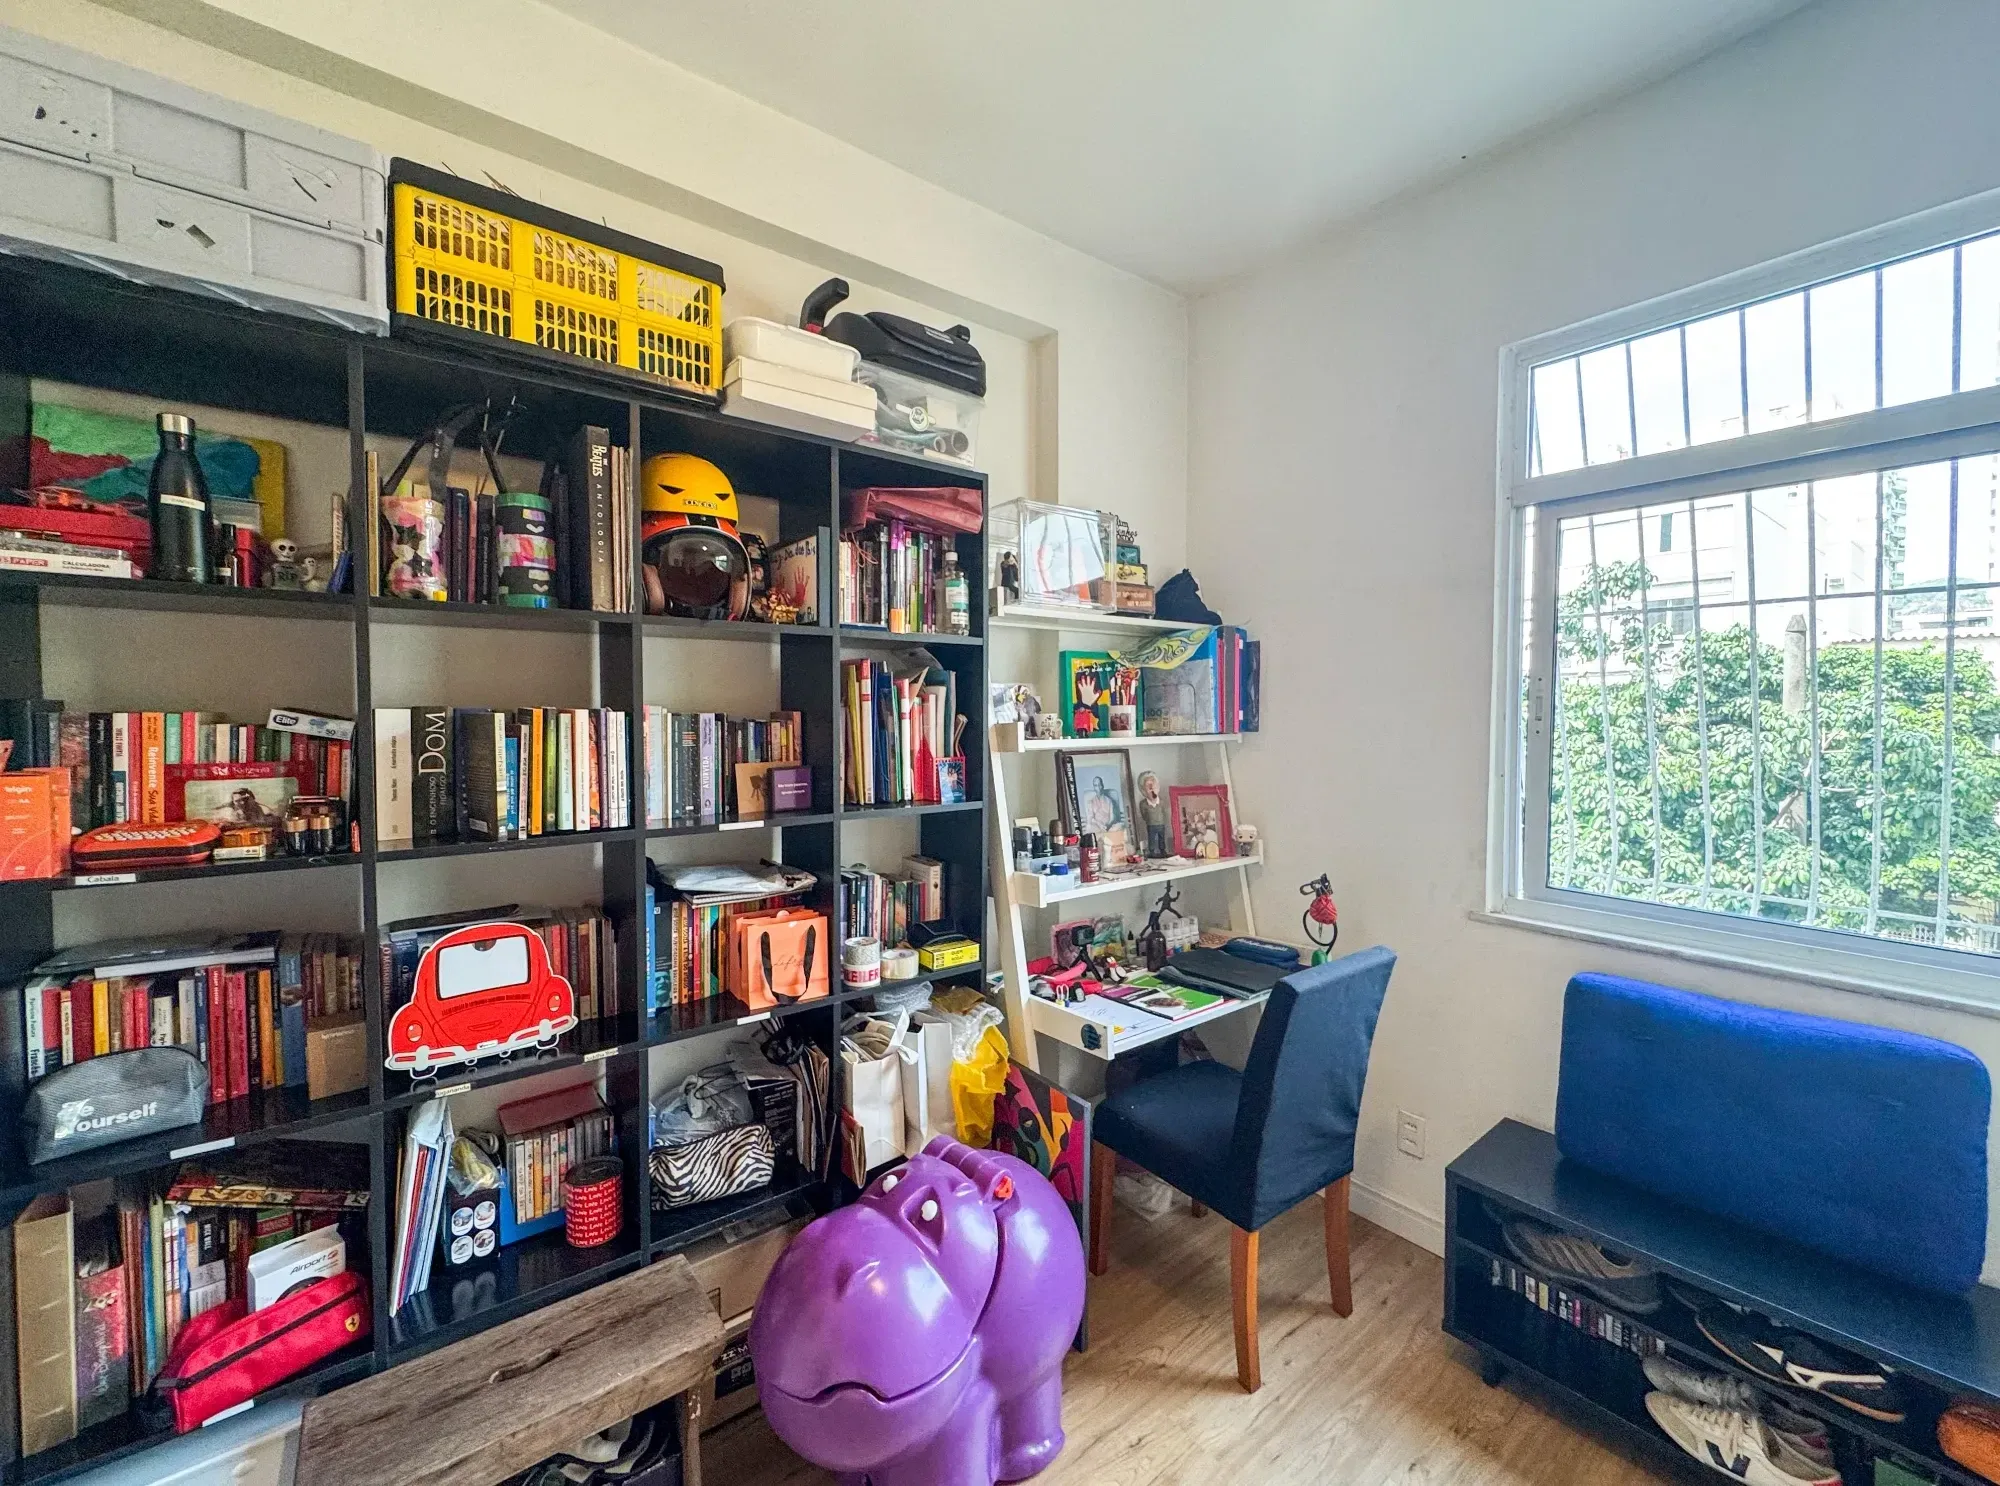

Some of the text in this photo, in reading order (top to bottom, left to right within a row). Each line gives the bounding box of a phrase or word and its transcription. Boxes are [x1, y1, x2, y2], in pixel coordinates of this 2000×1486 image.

[590, 444, 607, 477] BEATLES
[596, 483, 604, 562] ANTOLOGIA
[62, 560, 110, 568] CALCULADORA
[275, 715, 297, 725] Elite
[418, 711, 447, 776] DOM
[149, 746, 158, 788] Reinvente
[702, 756, 710, 789] AYURVEDA
[149, 789, 159, 805] Sua
[429, 776, 437, 818] ENGENHOSO
[87, 875, 120, 883] Cabala
[583, 1185, 598, 1193] Love
[588, 1207, 603, 1215] Love
[589, 1222, 603, 1230] Love
[589, 1237, 603, 1245] Love
[289, 1254, 327, 1276] Airport
